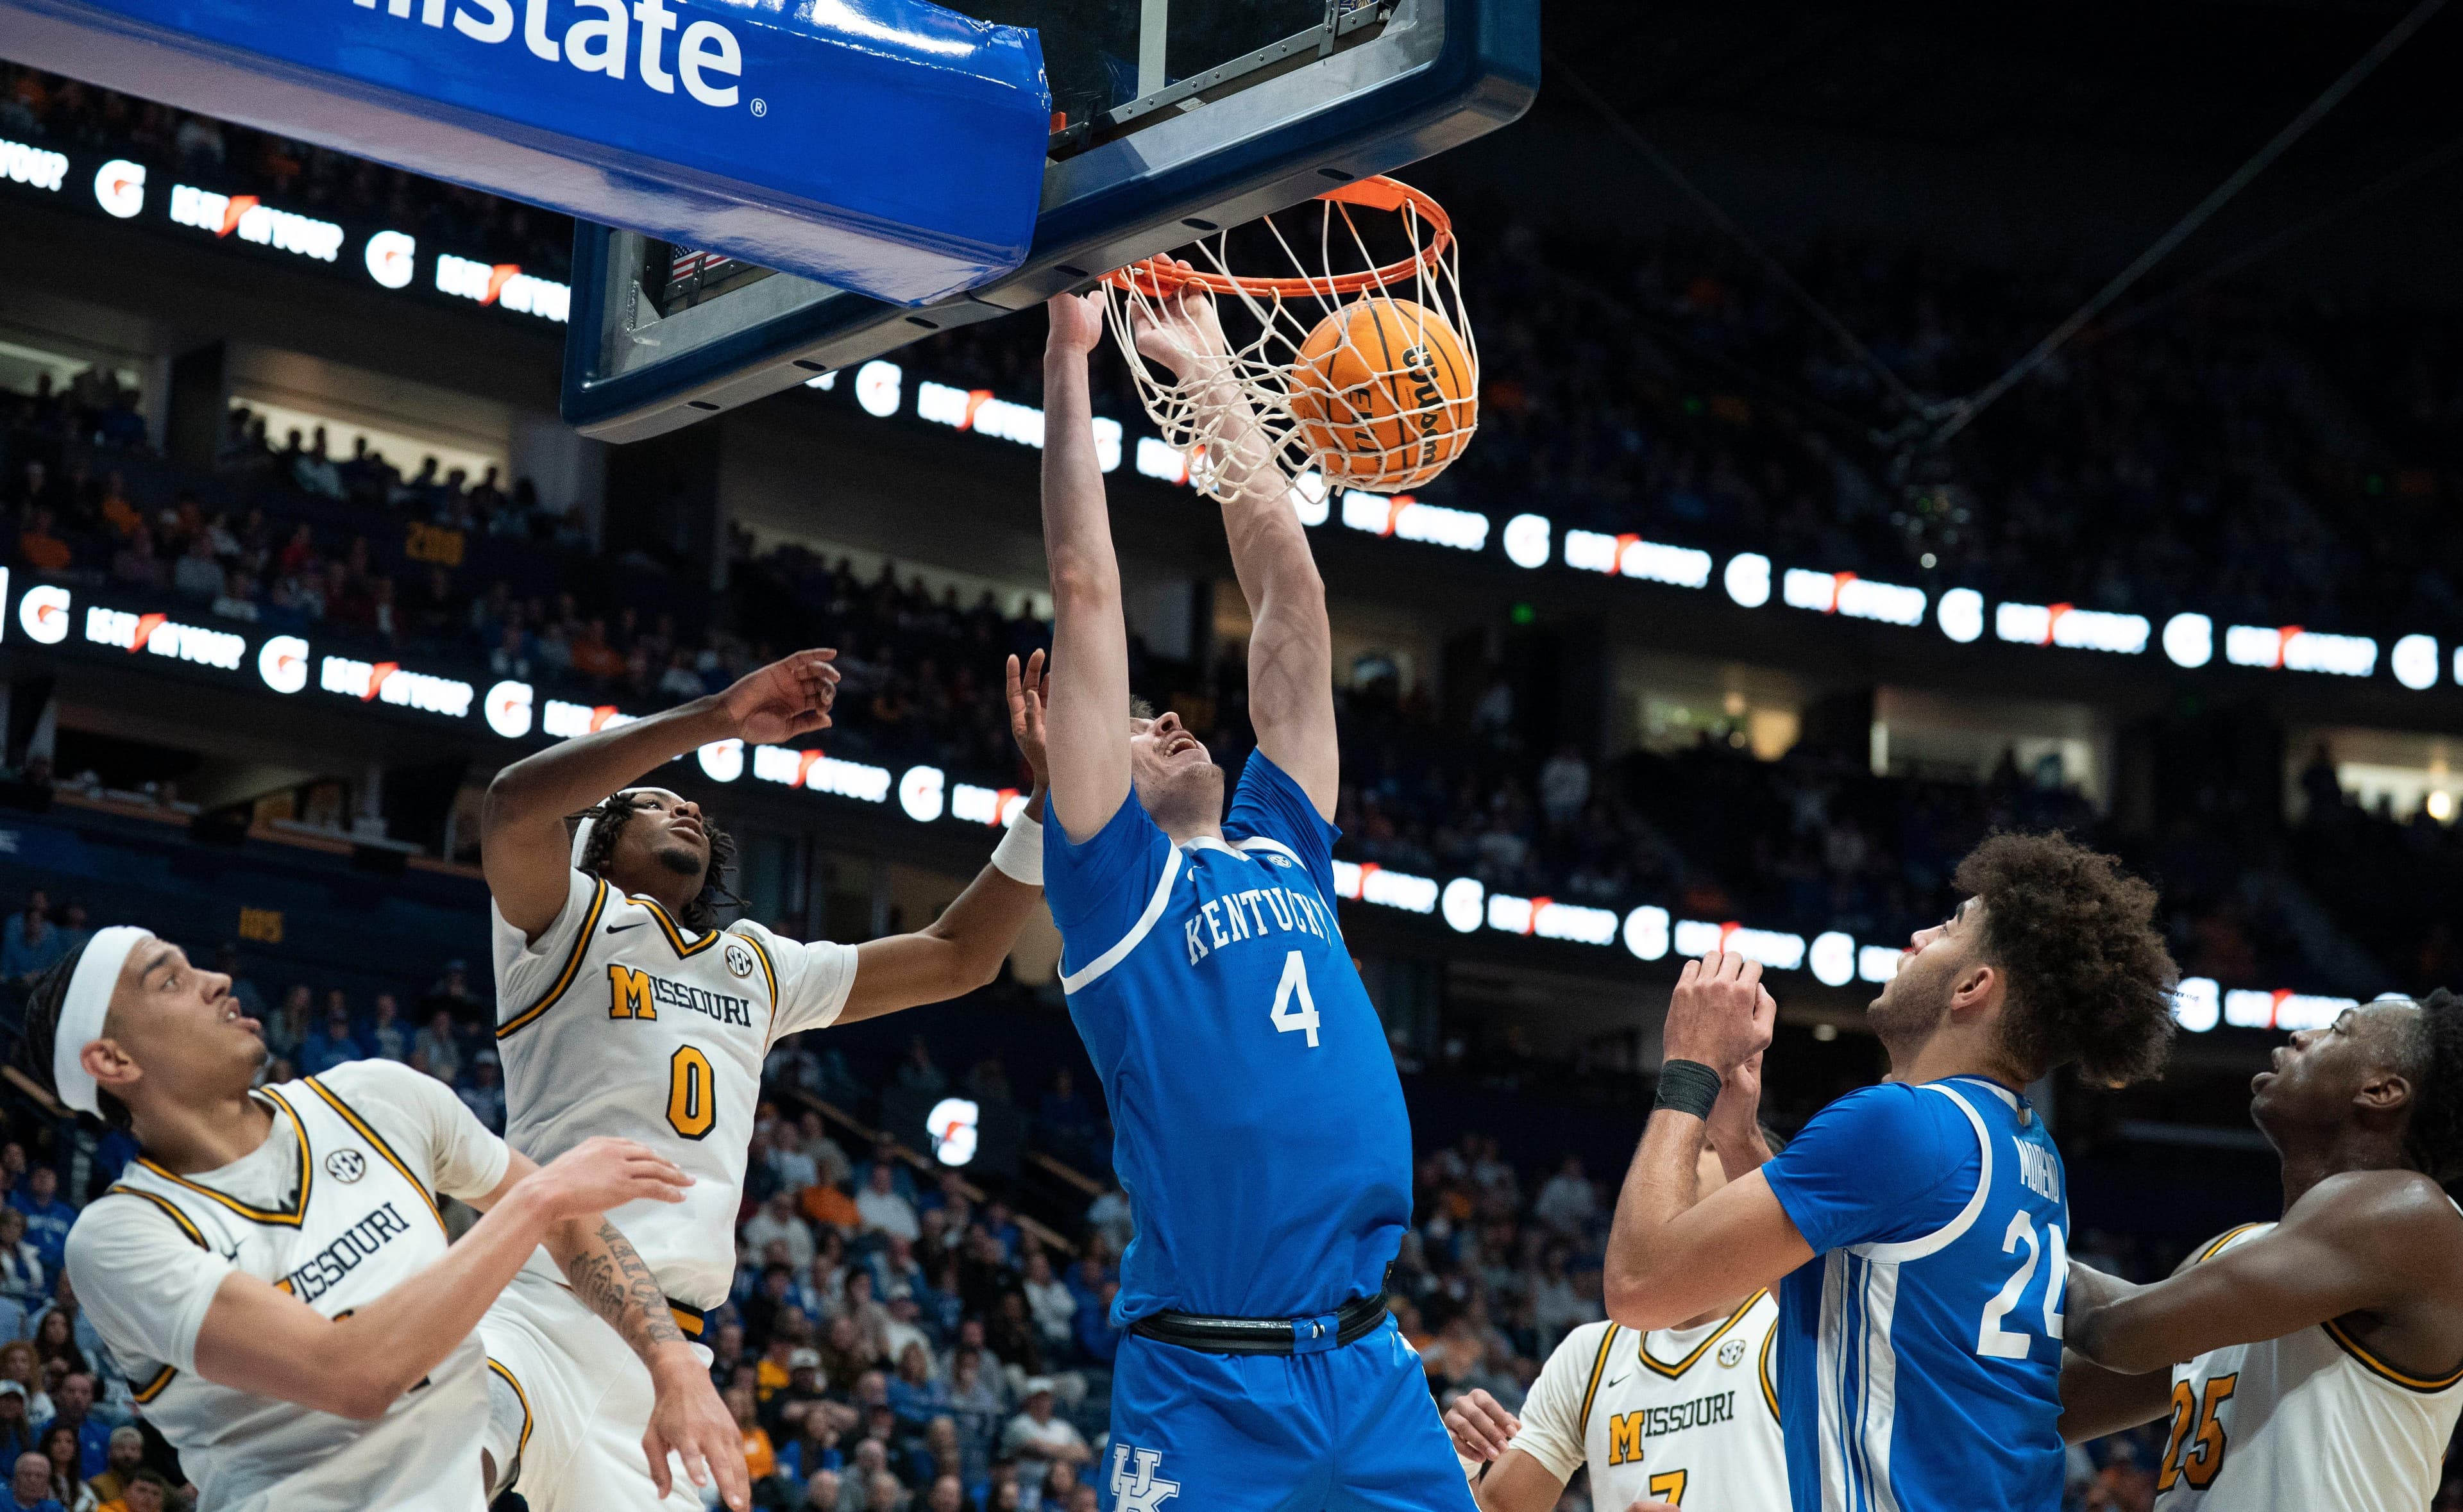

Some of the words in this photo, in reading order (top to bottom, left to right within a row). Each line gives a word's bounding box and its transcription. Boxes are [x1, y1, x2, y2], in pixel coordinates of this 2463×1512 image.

[607, 963, 752, 1027] MISSOURI
[725, 945, 752, 977] SEC
[1269, 950, 1321, 1048] 4
[665, 1043, 716, 1141] 0
[326, 1148, 366, 1184] SEC
[273, 1202, 410, 1304] ISSOURI
[1609, 1390, 1736, 1466] MISSOURI
[2156, 1371, 2239, 1497] 25
